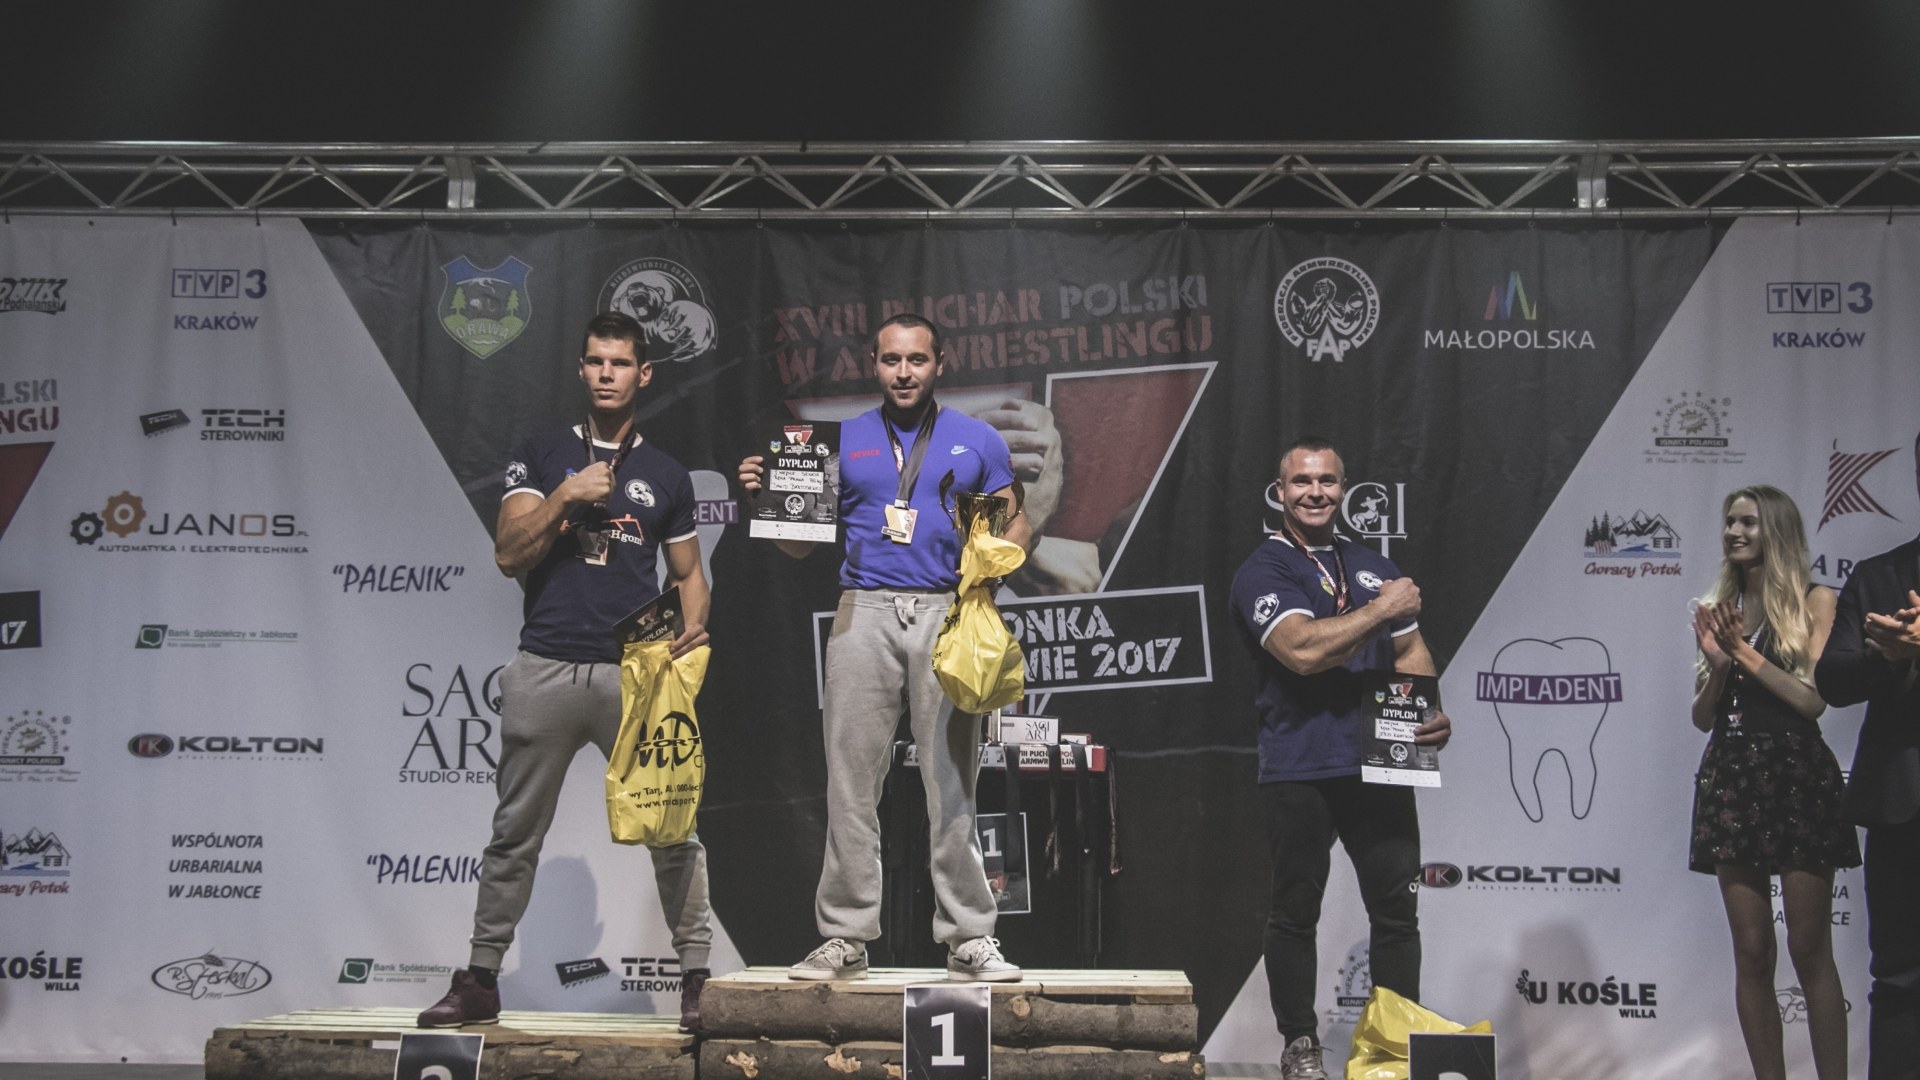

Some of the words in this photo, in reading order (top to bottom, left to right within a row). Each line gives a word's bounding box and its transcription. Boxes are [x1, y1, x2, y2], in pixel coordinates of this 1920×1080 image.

[175, 272, 237, 295] TVP
[245, 269, 267, 299] 3
[1059, 273, 1208, 320] POLSKI
[1292, 259, 1375, 296] ARMWRESTLING
[1355, 299, 1378, 342] POLSKA
[1769, 285, 1839, 311] TVP
[1847, 282, 1874, 314] 3
[173, 312, 259, 330] KRAKÓW
[456, 319, 510, 340] ORAWA
[1306, 322, 1352, 362] FAP
[1424, 329, 1596, 349] MAŁOPOLSKA
[1772, 328, 1867, 348] KRAKÓW
[202, 409, 285, 428] TECH
[200, 430, 285, 442] STEROWNIKI
[778, 458, 818, 470] DYPLOM
[98, 544, 177, 553] AUTOMATYKA
[190, 545, 309, 554] ELEKTROTECHNIKA
[1640, 561, 1682, 577] Potok
[1091, 636, 1182, 678] 2017
[1479, 674, 1620, 701] IMPLADENT
[1382, 708, 1418, 720] DYPLOM
[178, 736, 324, 754] KOŁTON
[399, 770, 461, 784] STUDIO
[171, 832, 264, 849] WSPÓLNOTA
[168, 859, 263, 874] URBARIALNA
[1467, 865, 1621, 884] KOŁTON
[29, 880, 69, 896] Potok
[168, 885, 185, 899] W
[186, 886, 263, 899] JABŁONCE
[374, 963, 396, 971] Bank
[399, 963, 452, 974] Spółdzielczy
[44, 982, 80, 992] WILLA
[1528, 981, 1548, 1005] U
[1557, 975, 1658, 1006] KOŚLE
[1618, 1008, 1657, 1019] WILLA
[931, 1012, 965, 1067] 1
